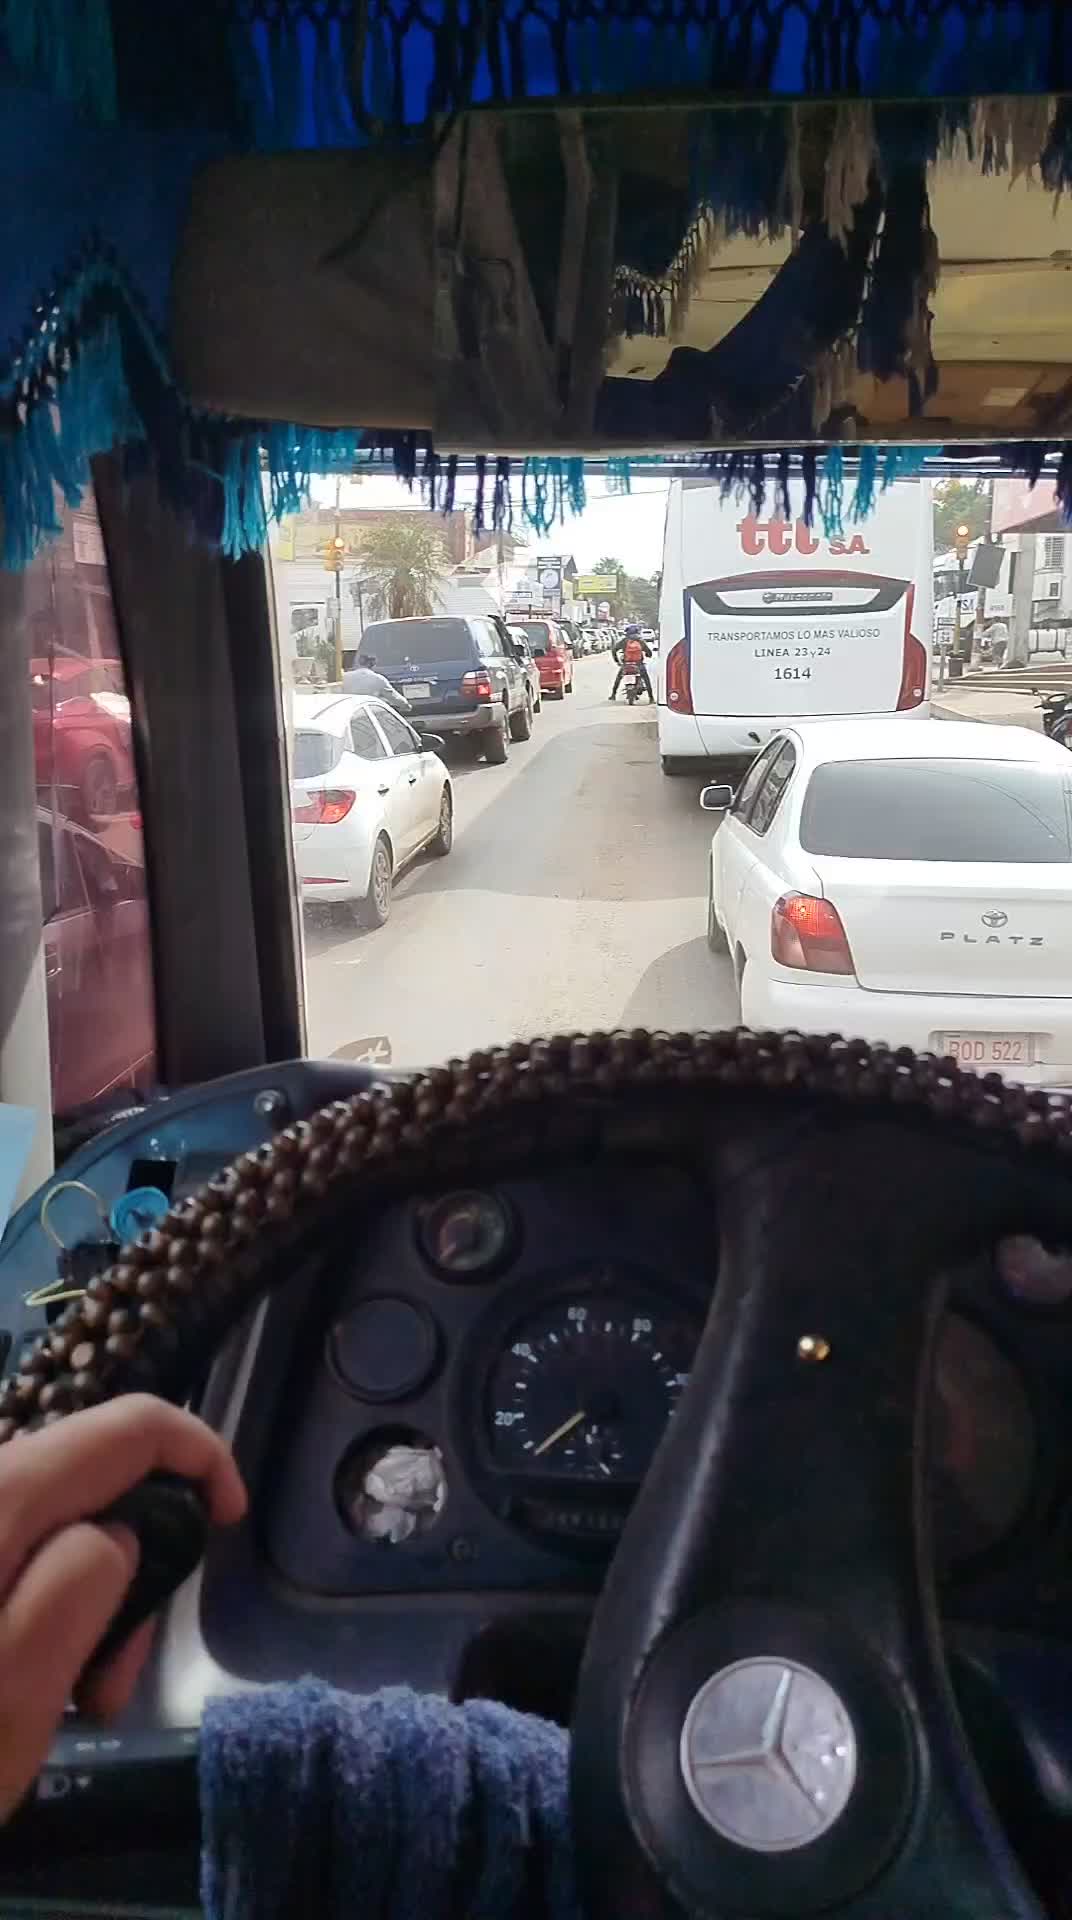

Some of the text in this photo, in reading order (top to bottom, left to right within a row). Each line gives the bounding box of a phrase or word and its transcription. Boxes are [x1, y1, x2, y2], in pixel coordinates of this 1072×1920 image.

[707, 628, 881, 641] TRANSPORTAMOS LO MAS VALIOSO
[754, 648, 790, 657] LINEA
[794, 648, 808, 656] 23
[817, 647, 831, 655] 24
[774, 667, 812, 680] 1614
[940, 932, 1044, 946] PLATZ
[992, 1041, 1022, 1061] 522
[567, 1307, 587, 1320] 60
[632, 1318, 652, 1332] 80
[511, 1343, 531, 1356] 40
[494, 1411, 514, 1426] 20
